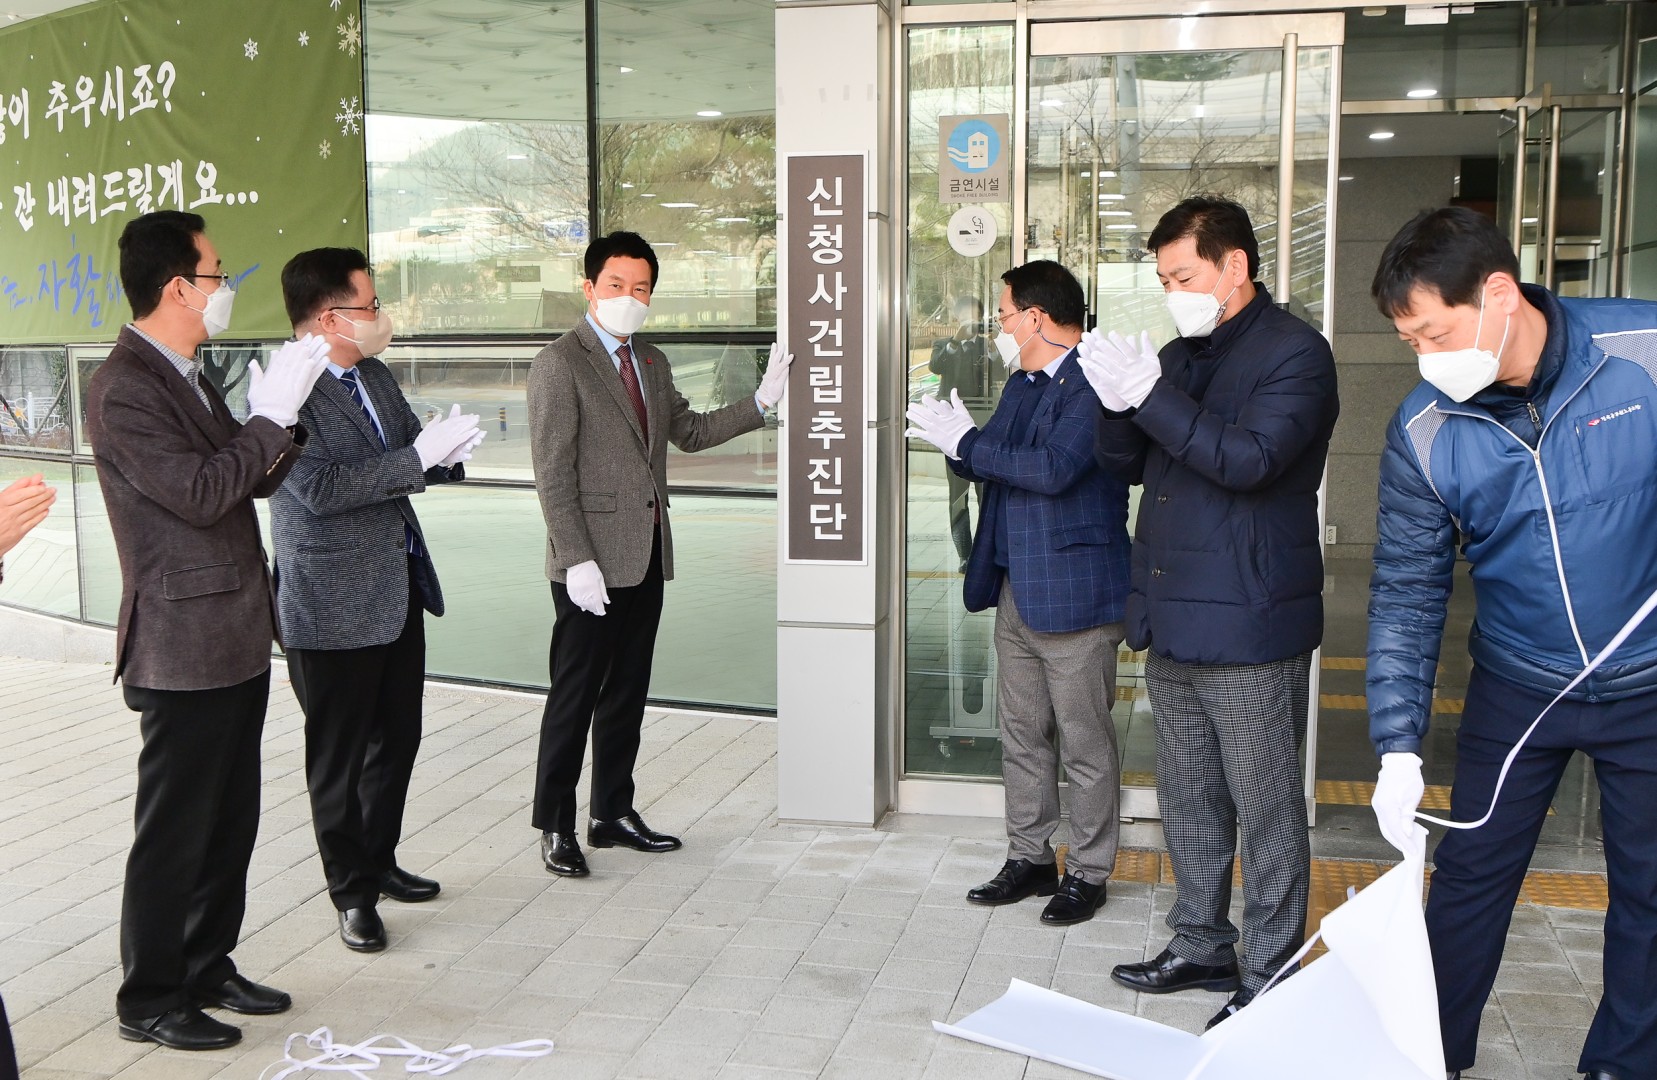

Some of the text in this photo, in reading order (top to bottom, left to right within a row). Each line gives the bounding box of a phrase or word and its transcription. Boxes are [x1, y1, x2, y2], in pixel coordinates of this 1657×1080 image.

[45, 61, 176, 133] 추우시죠?
[13, 181, 36, 232] 잔
[949, 177, 999, 192] 금연시설
[806, 176, 848, 540] 신청사건립추진단
